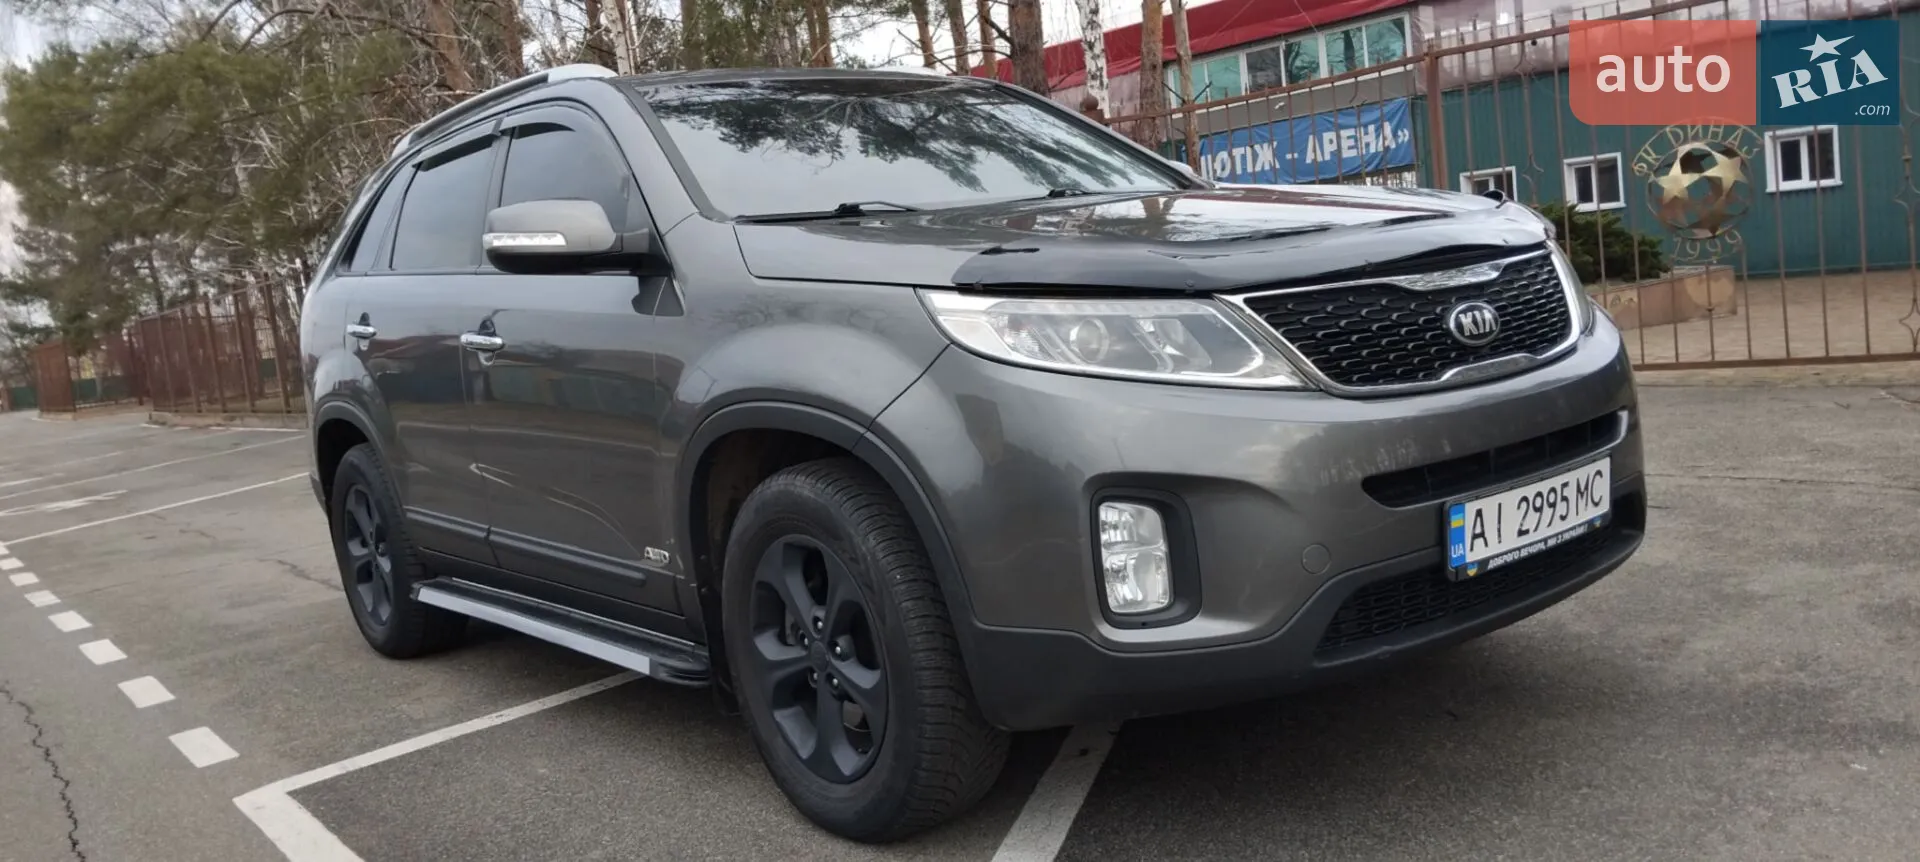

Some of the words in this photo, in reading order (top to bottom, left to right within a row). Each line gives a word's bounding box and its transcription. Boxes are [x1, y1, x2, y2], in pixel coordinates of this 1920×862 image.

[1670, 228, 1743, 261] 1999
[1459, 309, 1496, 337] KIA
[1469, 502, 1503, 552] AI
[1516, 480, 1570, 538] 2995
[1575, 469, 1604, 517] MC
[1451, 543, 1465, 558] UA
[1488, 550, 1520, 570] ДОБРОГО
